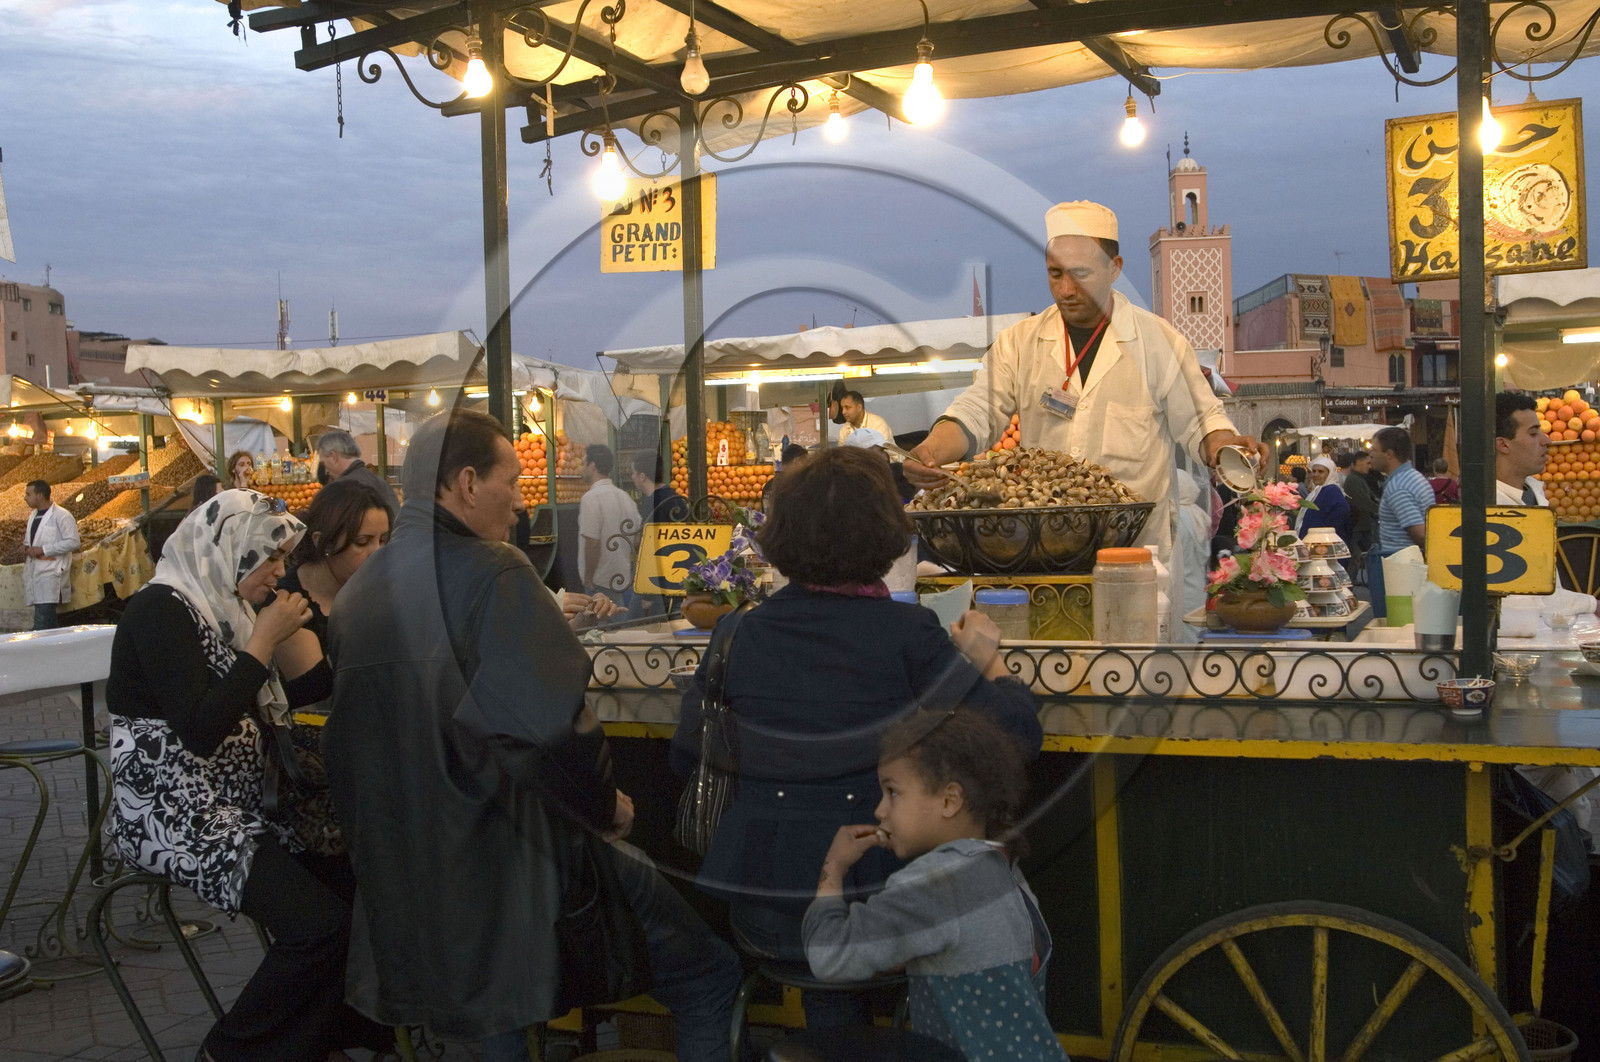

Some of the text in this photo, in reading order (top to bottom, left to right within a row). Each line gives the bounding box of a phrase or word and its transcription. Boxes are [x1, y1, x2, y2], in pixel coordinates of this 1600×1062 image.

[1408, 172, 1454, 239] 3
[611, 222, 681, 244] GRAND
[365, 390, 387, 401] 44
[658, 528, 717, 540] HASAN
[648, 543, 707, 590] 3
[1445, 522, 1528, 584] 3
